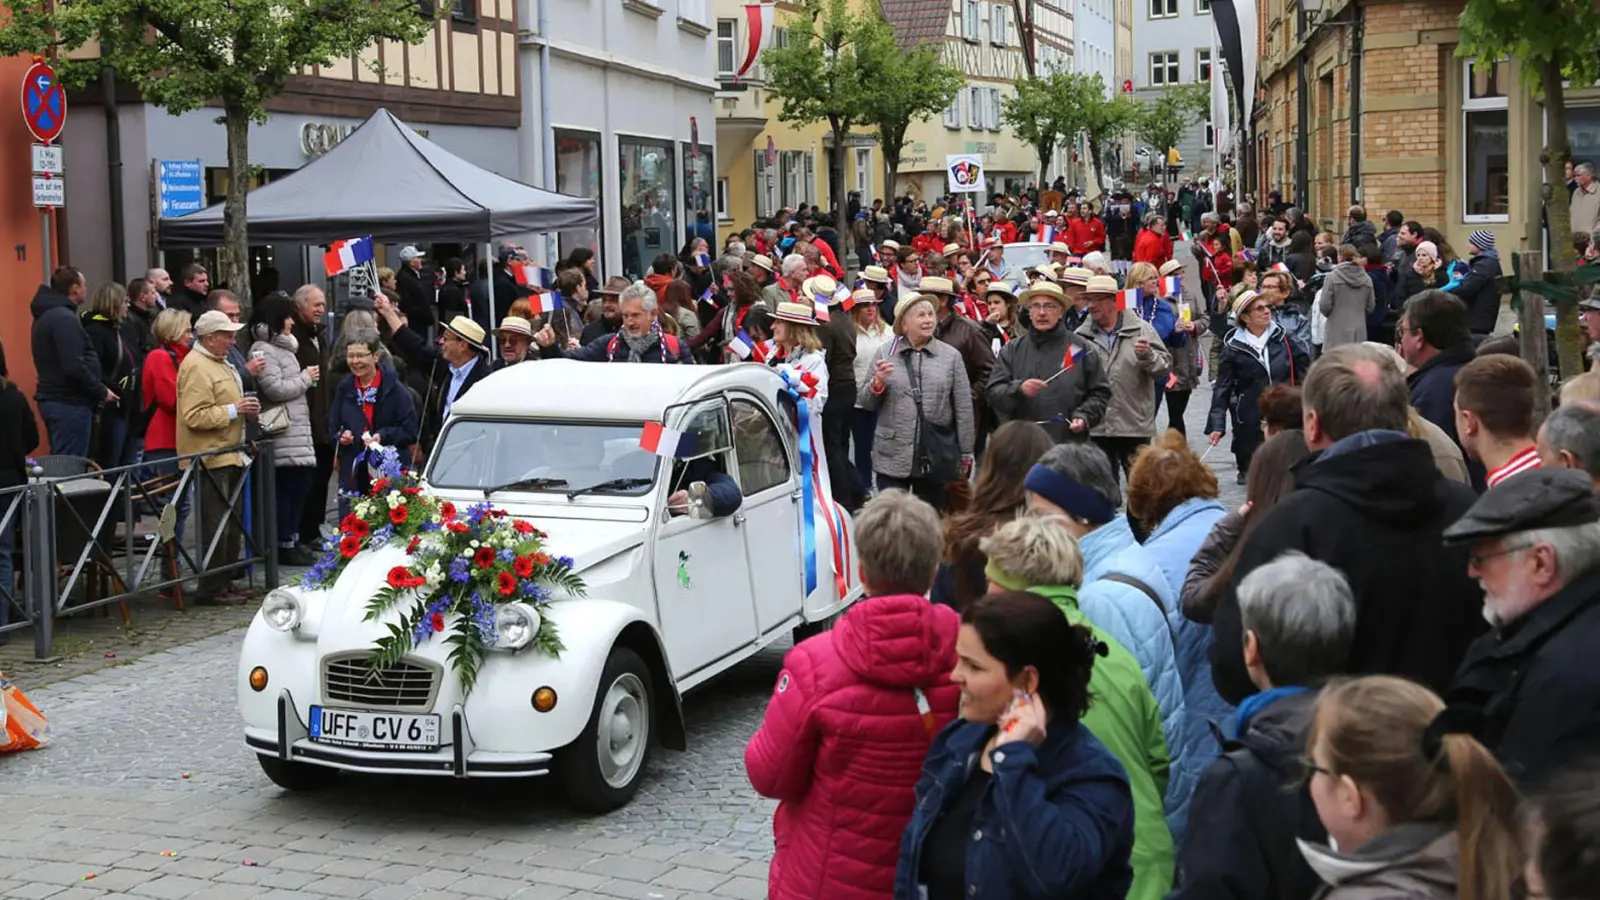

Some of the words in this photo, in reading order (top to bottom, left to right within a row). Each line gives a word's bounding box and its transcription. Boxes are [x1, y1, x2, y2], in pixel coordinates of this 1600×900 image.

[172, 200, 199, 210] Finanzamt
[322, 712, 358, 737] UFF
[373, 717, 402, 740] CV
[408, 718, 422, 741] 6
